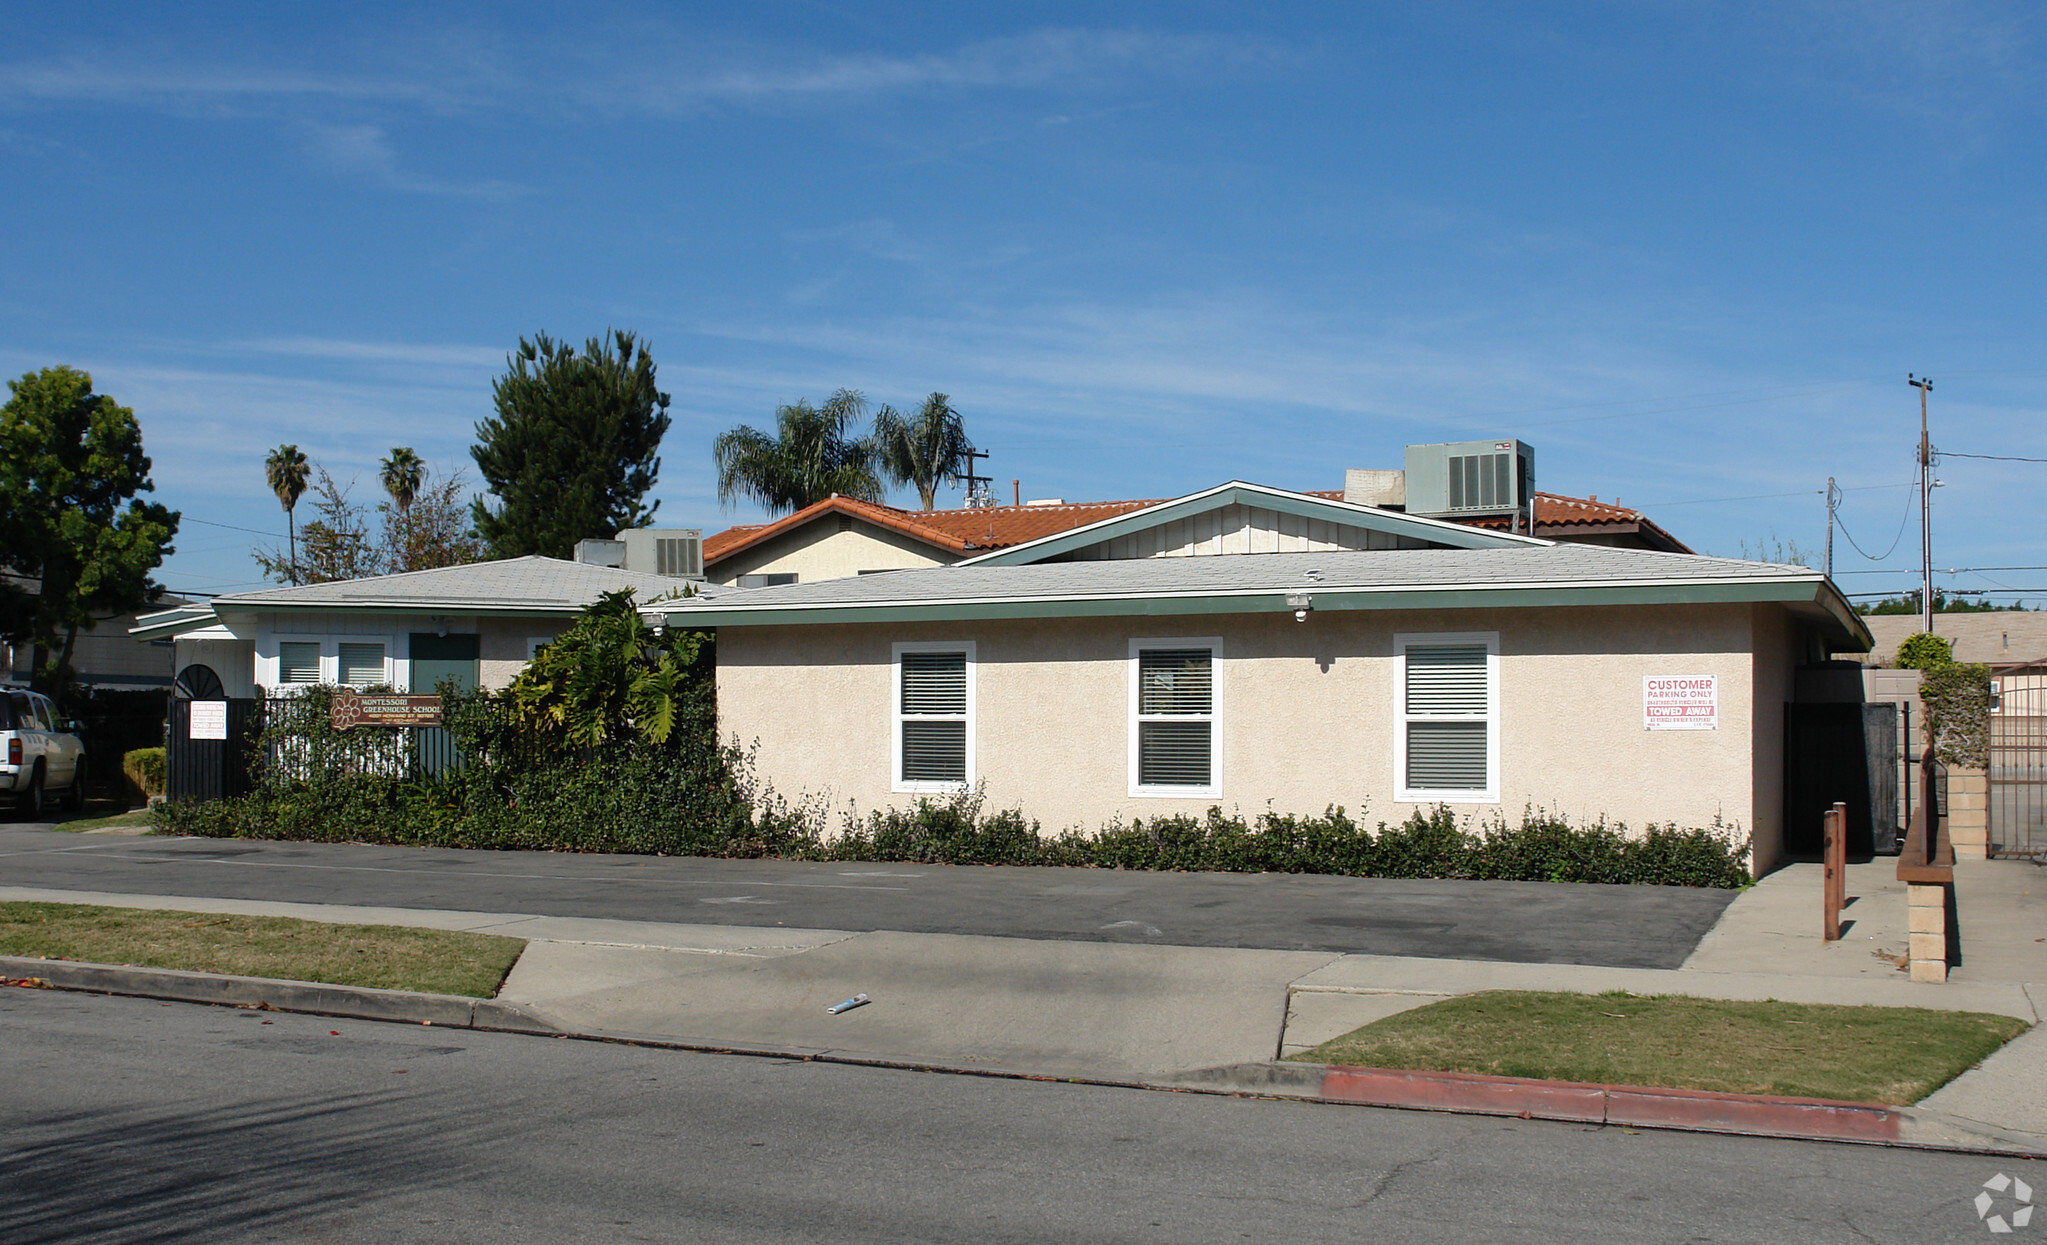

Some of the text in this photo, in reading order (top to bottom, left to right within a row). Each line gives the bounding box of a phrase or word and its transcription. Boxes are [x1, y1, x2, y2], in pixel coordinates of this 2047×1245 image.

[1648, 680, 1712, 690] CUSTOMER
[1648, 706, 1712, 716] TOWED AWAY
